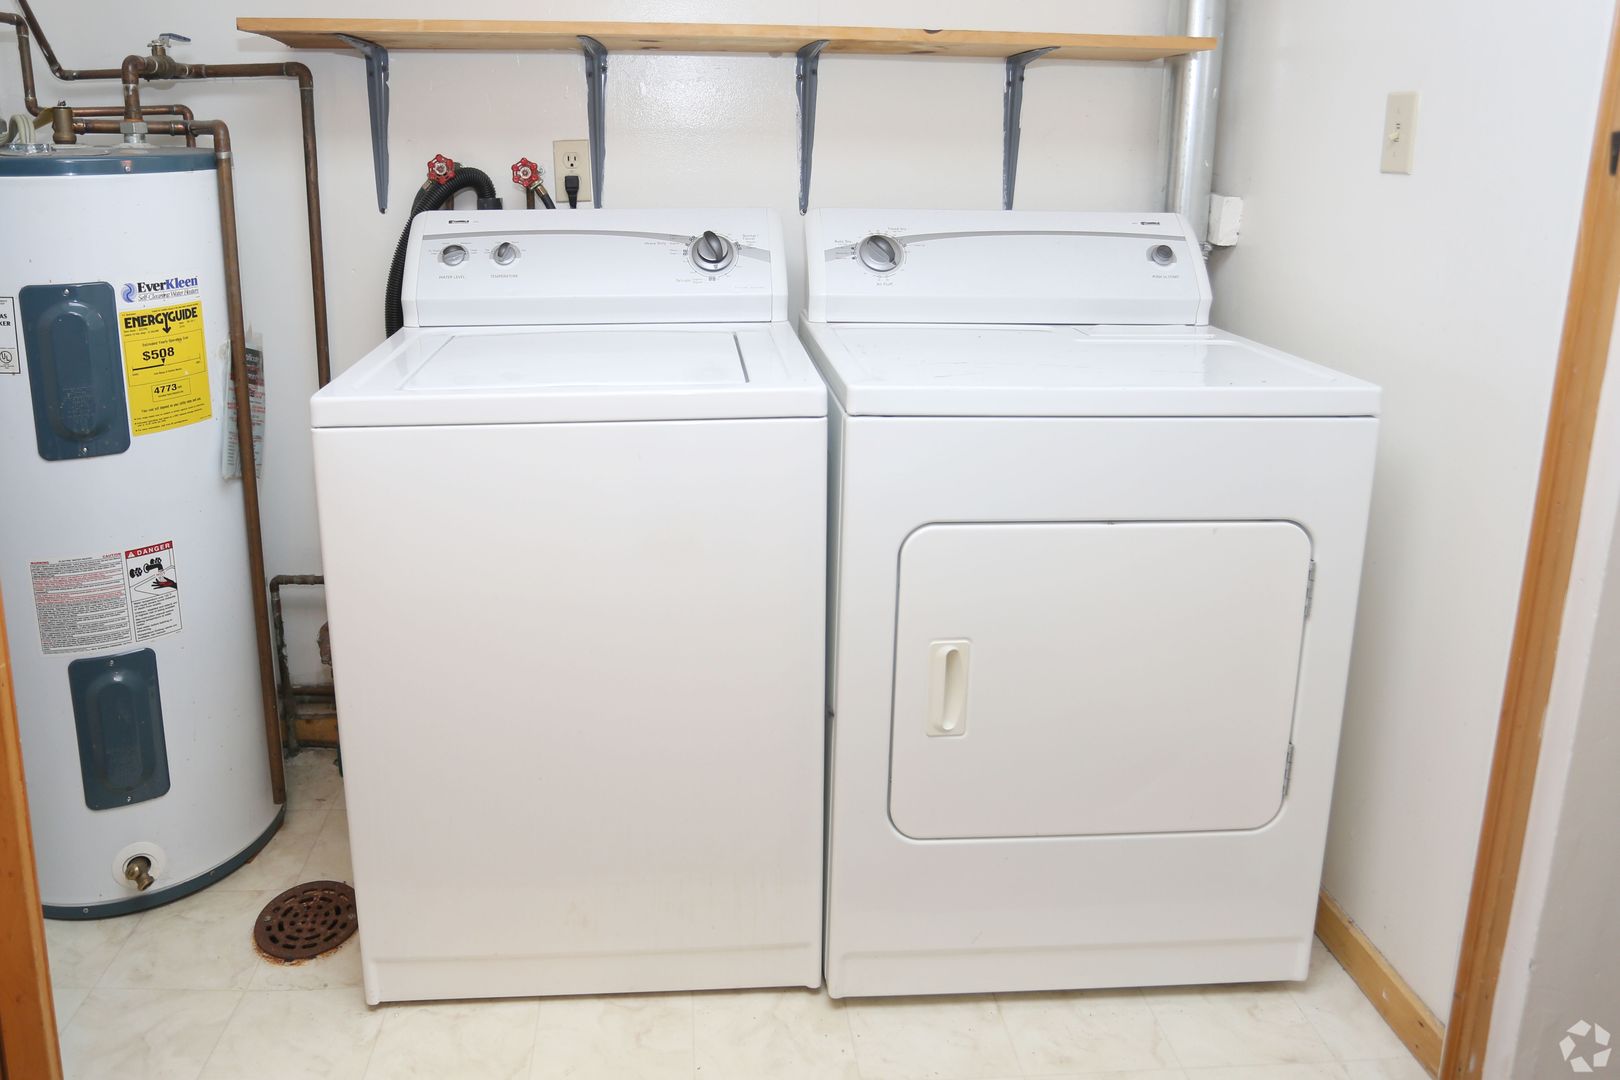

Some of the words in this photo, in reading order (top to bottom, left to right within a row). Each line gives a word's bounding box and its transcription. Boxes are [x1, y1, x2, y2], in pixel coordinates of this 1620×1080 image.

[137, 276, 198, 293] EverKleen
[124, 307, 198, 329] ENERGYGUIDE
[142, 347, 175, 361] $508
[154, 383, 177, 394] 4773
[137, 543, 170, 556] DANGER
